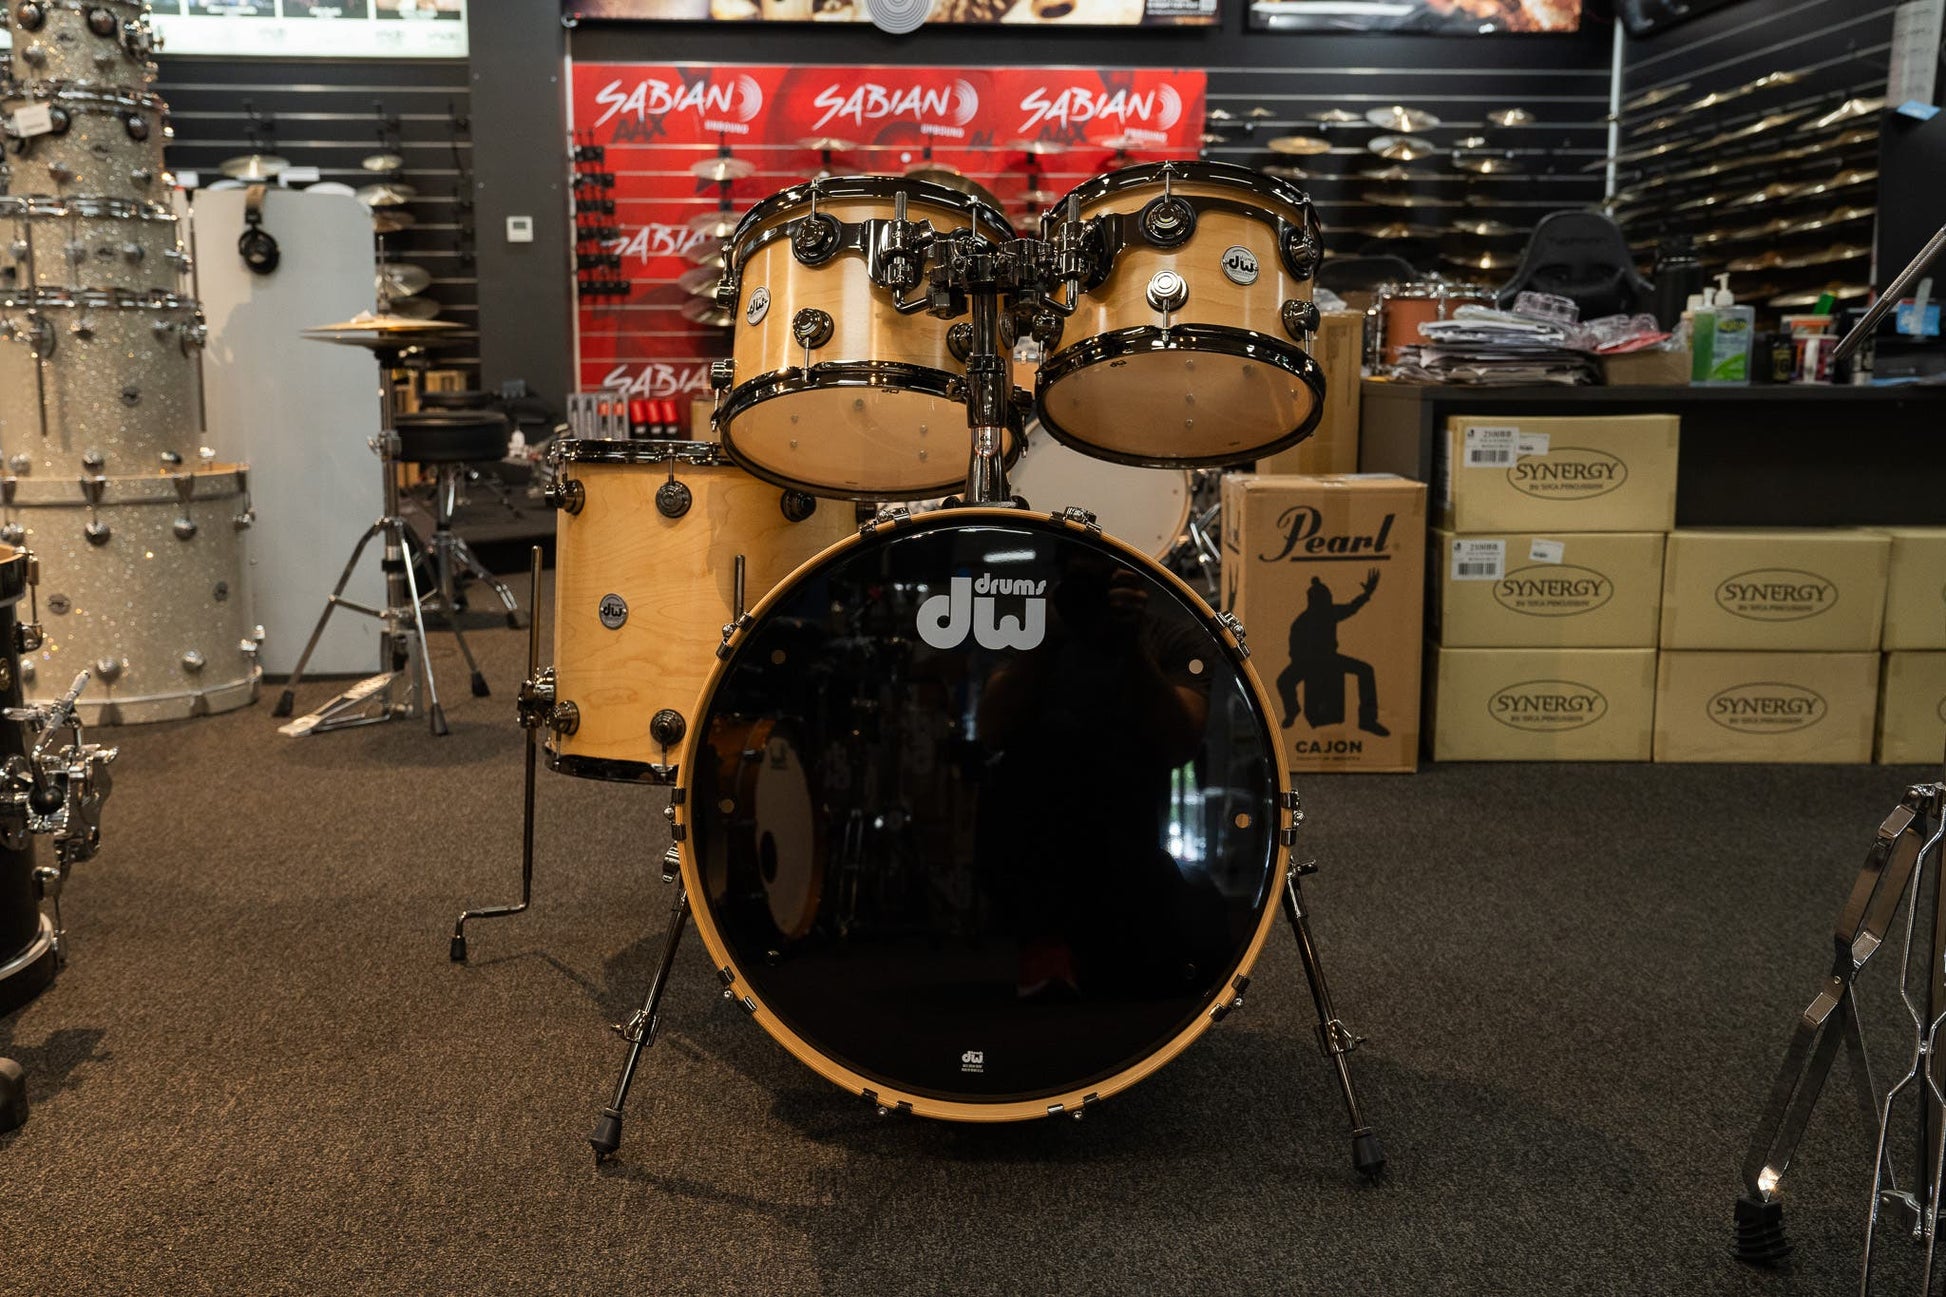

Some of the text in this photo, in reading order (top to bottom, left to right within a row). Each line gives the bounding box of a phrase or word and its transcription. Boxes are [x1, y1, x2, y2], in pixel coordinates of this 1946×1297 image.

[594, 79, 735, 128] SABIAN
[812, 83, 951, 131] SABIAN
[1017, 86, 1156, 133] SABIAN
[603, 364, 711, 398] SABIA
[1515, 463, 1619, 481] SYNERGY
[1258, 505, 1396, 562] Pearl
[974, 573, 1047, 595] drums
[1501, 579, 1605, 597] SYNERGY
[1723, 583, 1830, 602] SYNERGY
[916, 577, 1046, 650] dw
[1497, 695, 1599, 712] SYNERGY
[1715, 697, 1819, 715] SYNERGY
[1296, 740, 1362, 754] CAJON
